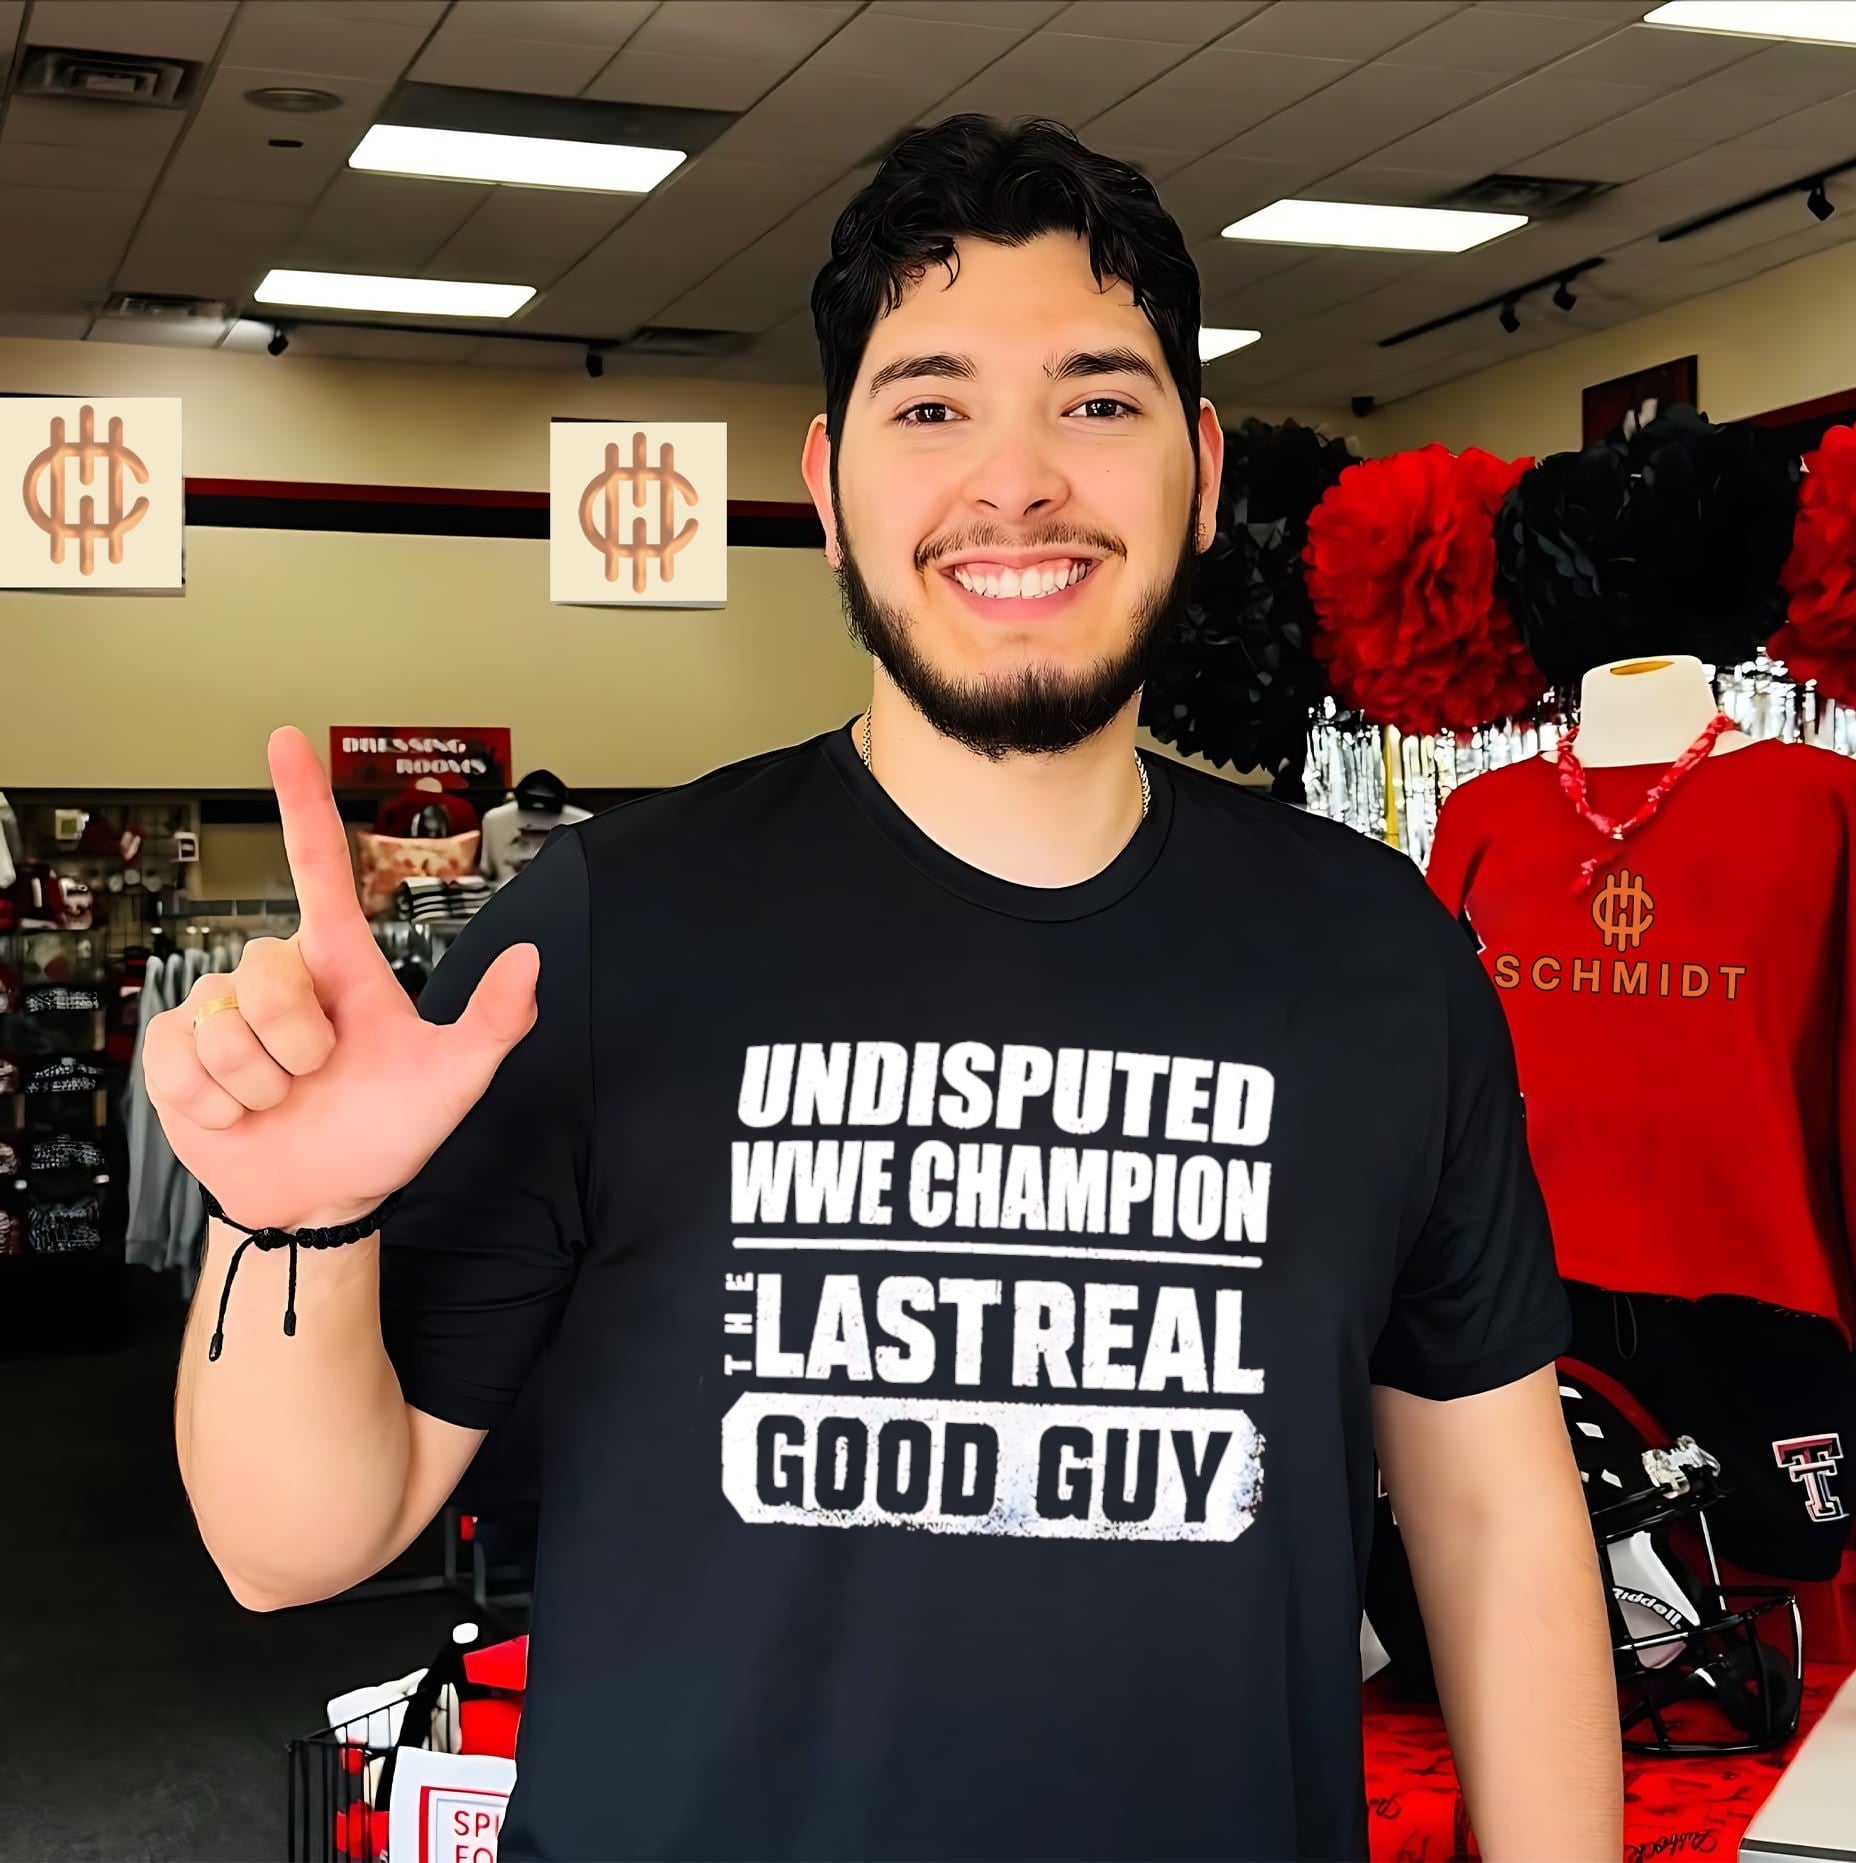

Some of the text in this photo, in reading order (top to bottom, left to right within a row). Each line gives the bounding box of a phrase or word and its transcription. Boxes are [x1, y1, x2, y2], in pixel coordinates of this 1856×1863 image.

[396, 758, 487, 774] ROOMS
[1494, 954, 1747, 1000] SCHMIDT
[737, 1041, 1275, 1146] UNDISPUTED
[731, 1140, 1272, 1243] WWE CHAMPION
[724, 1272, 1265, 1394] THE LAST REAL
[756, 1414, 1233, 1524] GOOD GUY
